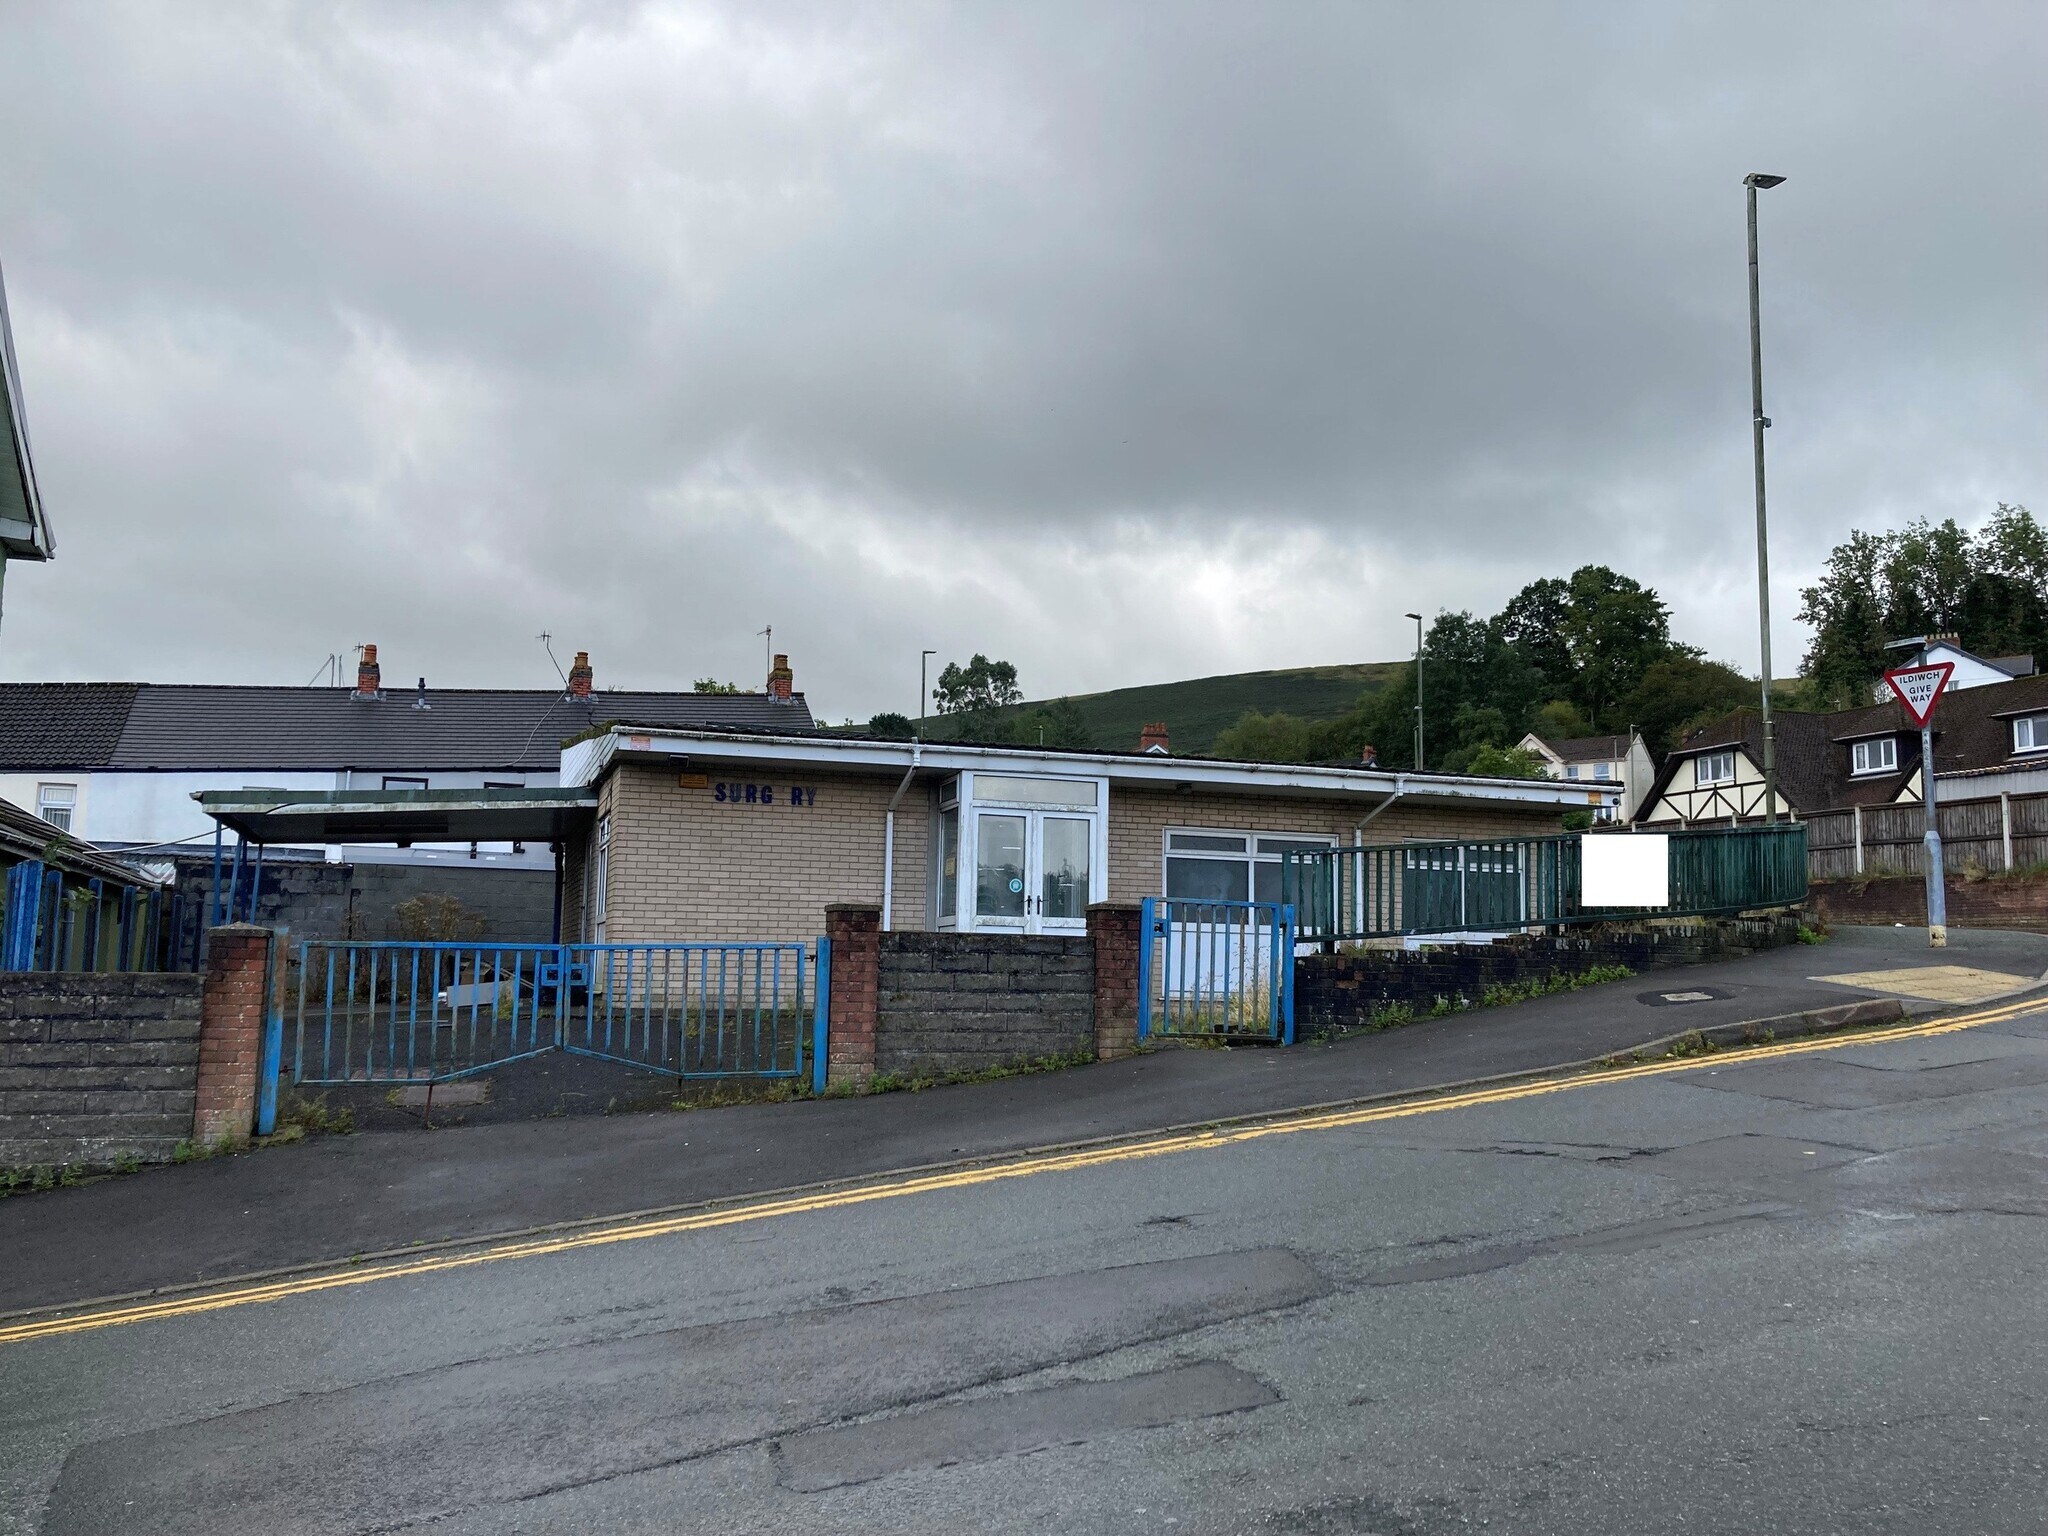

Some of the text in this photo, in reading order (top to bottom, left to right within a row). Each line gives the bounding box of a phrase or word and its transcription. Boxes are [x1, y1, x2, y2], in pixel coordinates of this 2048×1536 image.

[1900, 671, 1940, 684] ILDIWCH
[1909, 684, 1931, 694] GIVE
[1910, 693, 1931, 703] WAY
[715, 783, 817, 806] SURGRY
